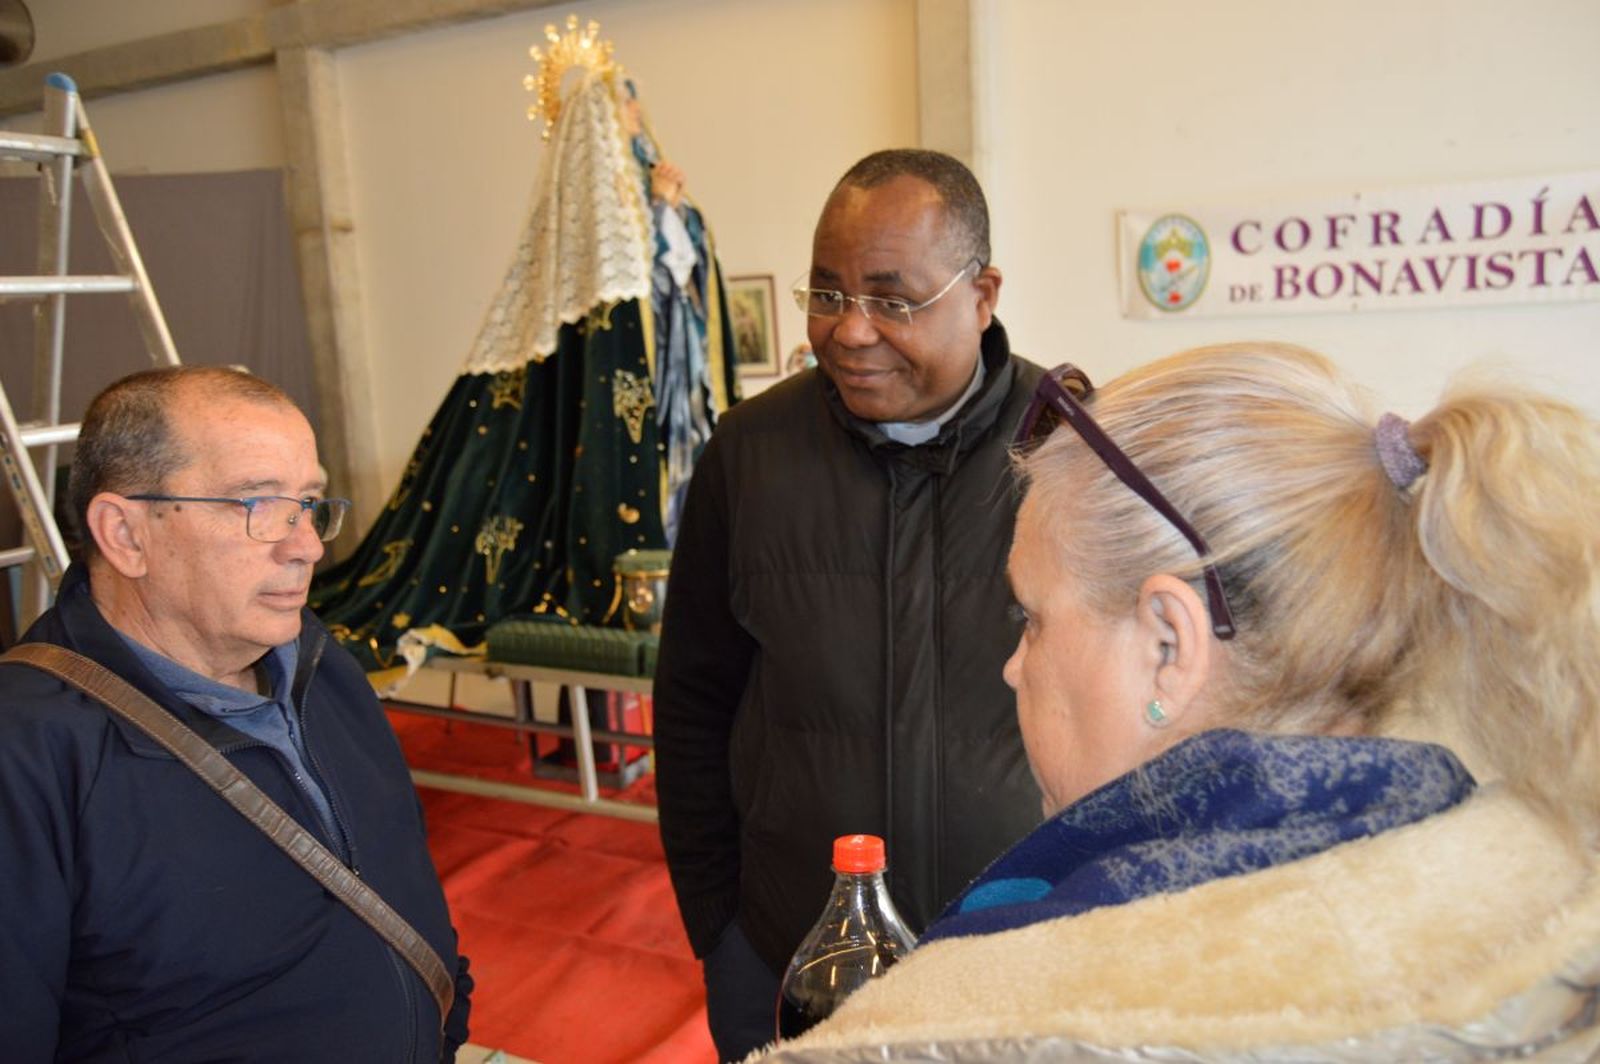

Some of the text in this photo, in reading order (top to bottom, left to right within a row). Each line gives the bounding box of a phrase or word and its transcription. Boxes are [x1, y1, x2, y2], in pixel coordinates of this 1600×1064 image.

[1230, 186, 1600, 255] COFRADÍA
[1229, 247, 1600, 303] DE BONAVISTA
